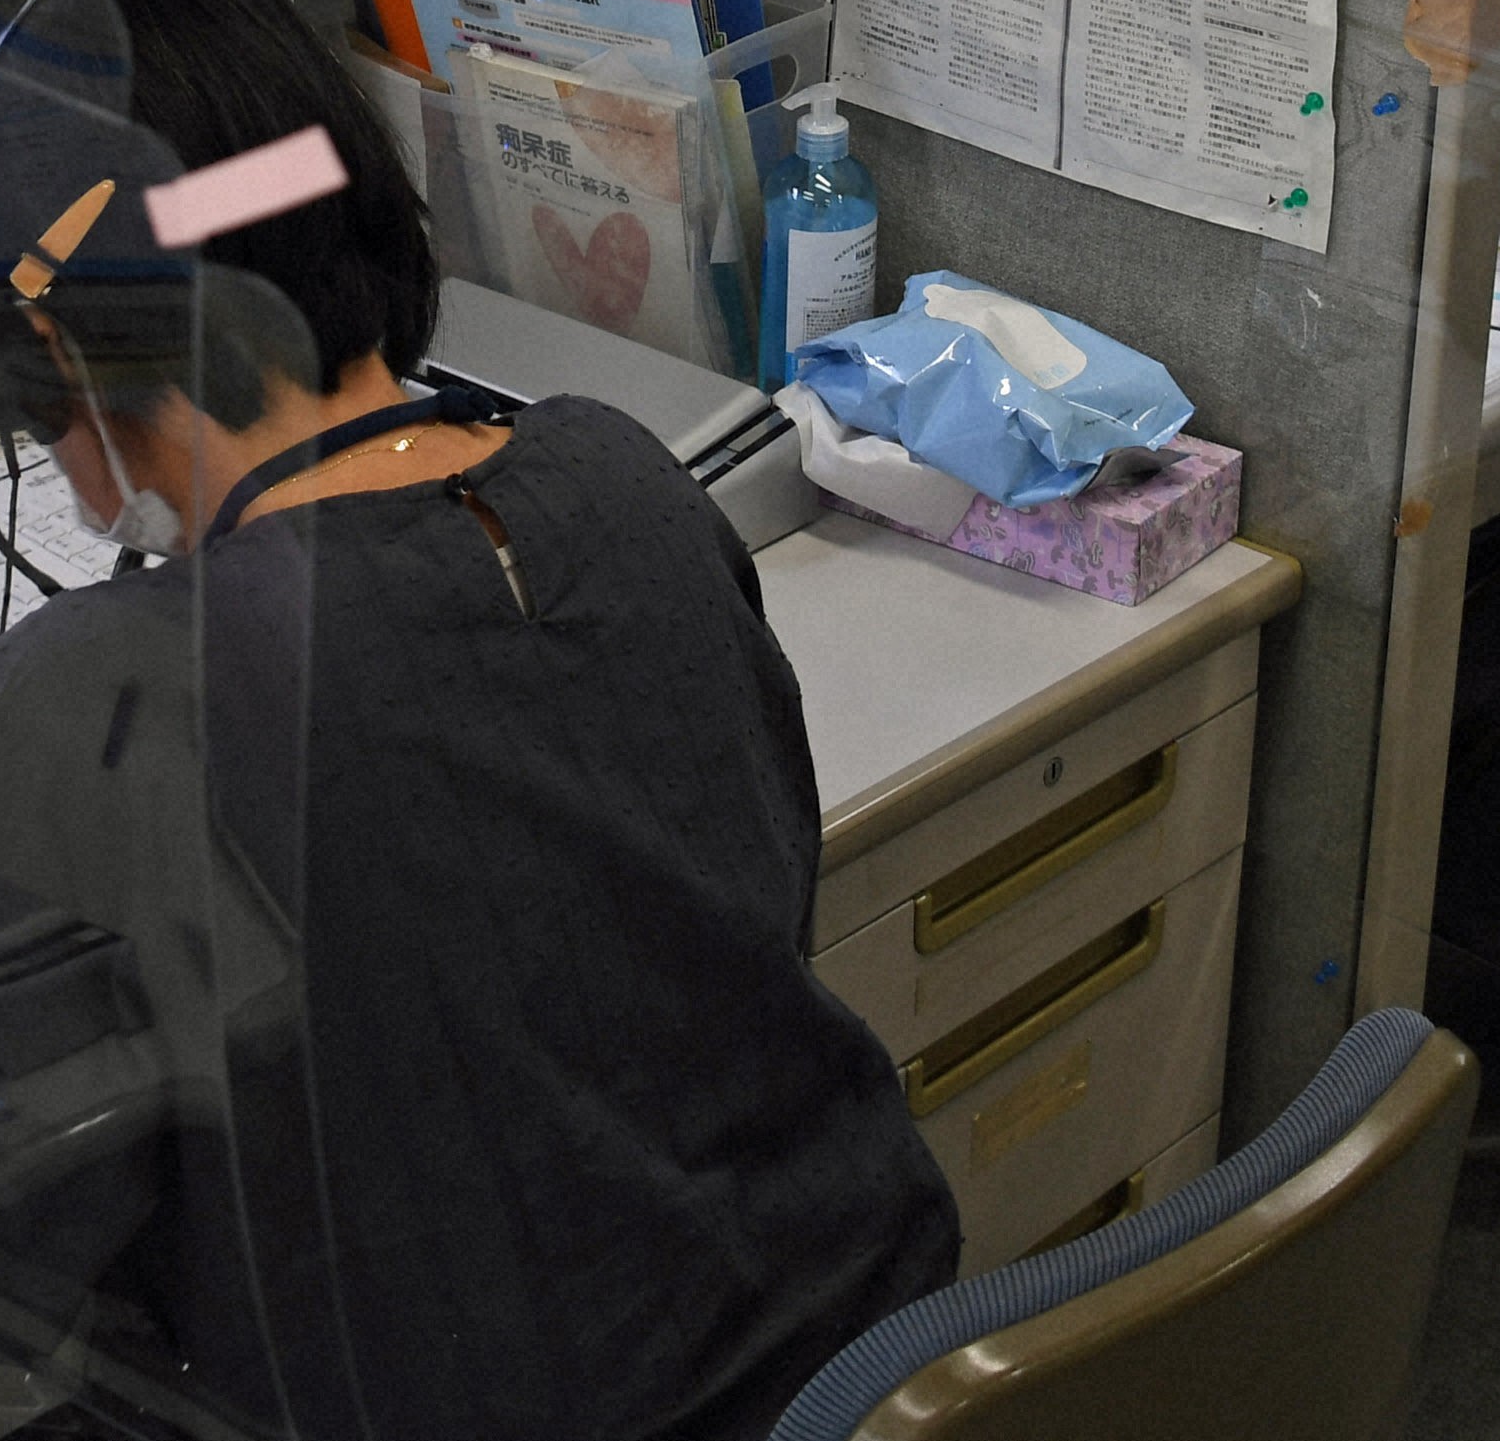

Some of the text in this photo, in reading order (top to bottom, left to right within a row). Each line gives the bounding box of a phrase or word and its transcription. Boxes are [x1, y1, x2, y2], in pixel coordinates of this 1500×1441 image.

[501, 150, 631, 204] のすべてに答える
